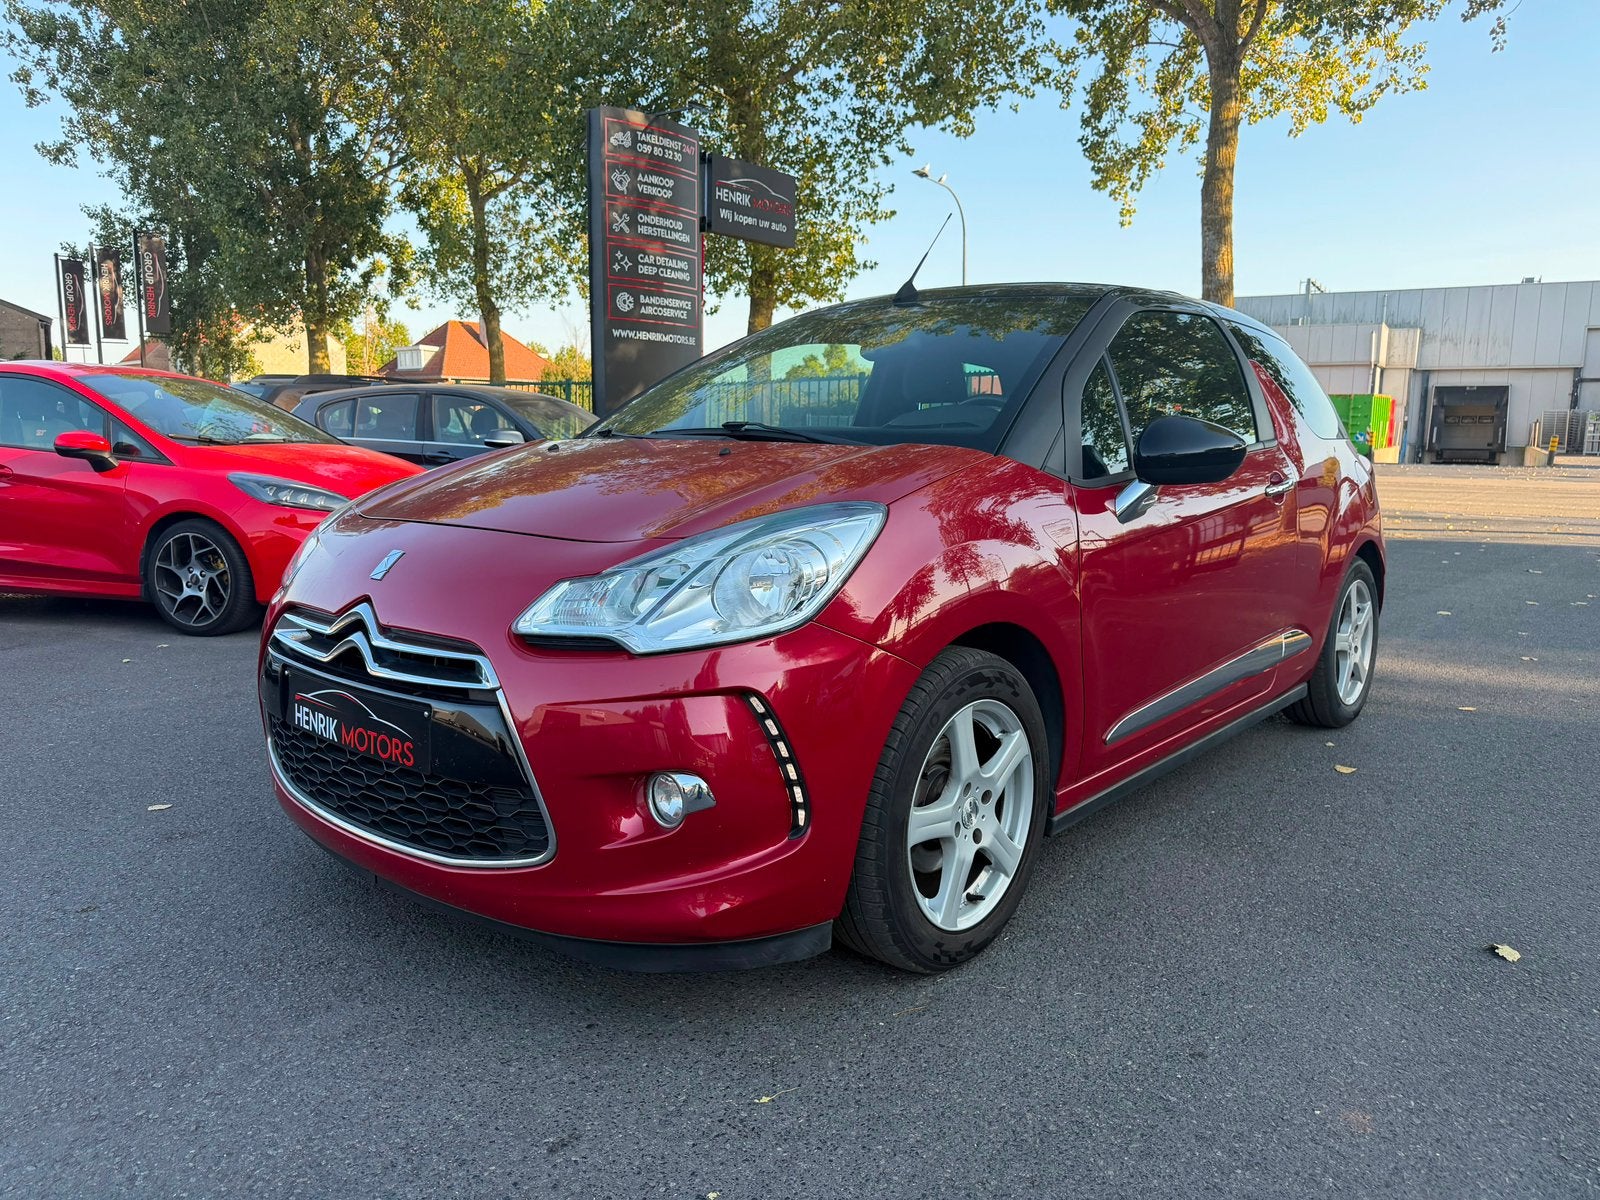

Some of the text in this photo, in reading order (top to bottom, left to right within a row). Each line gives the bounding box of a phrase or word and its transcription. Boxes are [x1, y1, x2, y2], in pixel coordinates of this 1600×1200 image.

[636, 131, 695, 156] TAKELDIENST 24/7
[636, 143, 682, 162] 059 80 32 30
[637, 173, 674, 188] AANKOOP
[637, 183, 673, 199] VERKOOP
[715, 186, 751, 208] HENRIK
[637, 213, 683, 230] ONDERHOUD
[719, 207, 787, 233] Wij kopen uw auto
[637, 224, 690, 244] HERSTELLINGEN
[637, 253, 689, 270] CAR DETAILING
[638, 264, 690, 282] DEEP CLEANING
[65, 272, 75, 302] GROUP
[144, 251, 156, 318] GROUP HENRIK
[100, 263, 113, 326] HENRIK MOTORS
[640, 294, 692, 310] BANDENSERVICE
[640, 305, 687, 319] AIRCOSERVICE
[612, 328, 696, 346] WWW.HENRIKMOTORS.BE
[294, 703, 415, 767] HENRIK MOTORS
